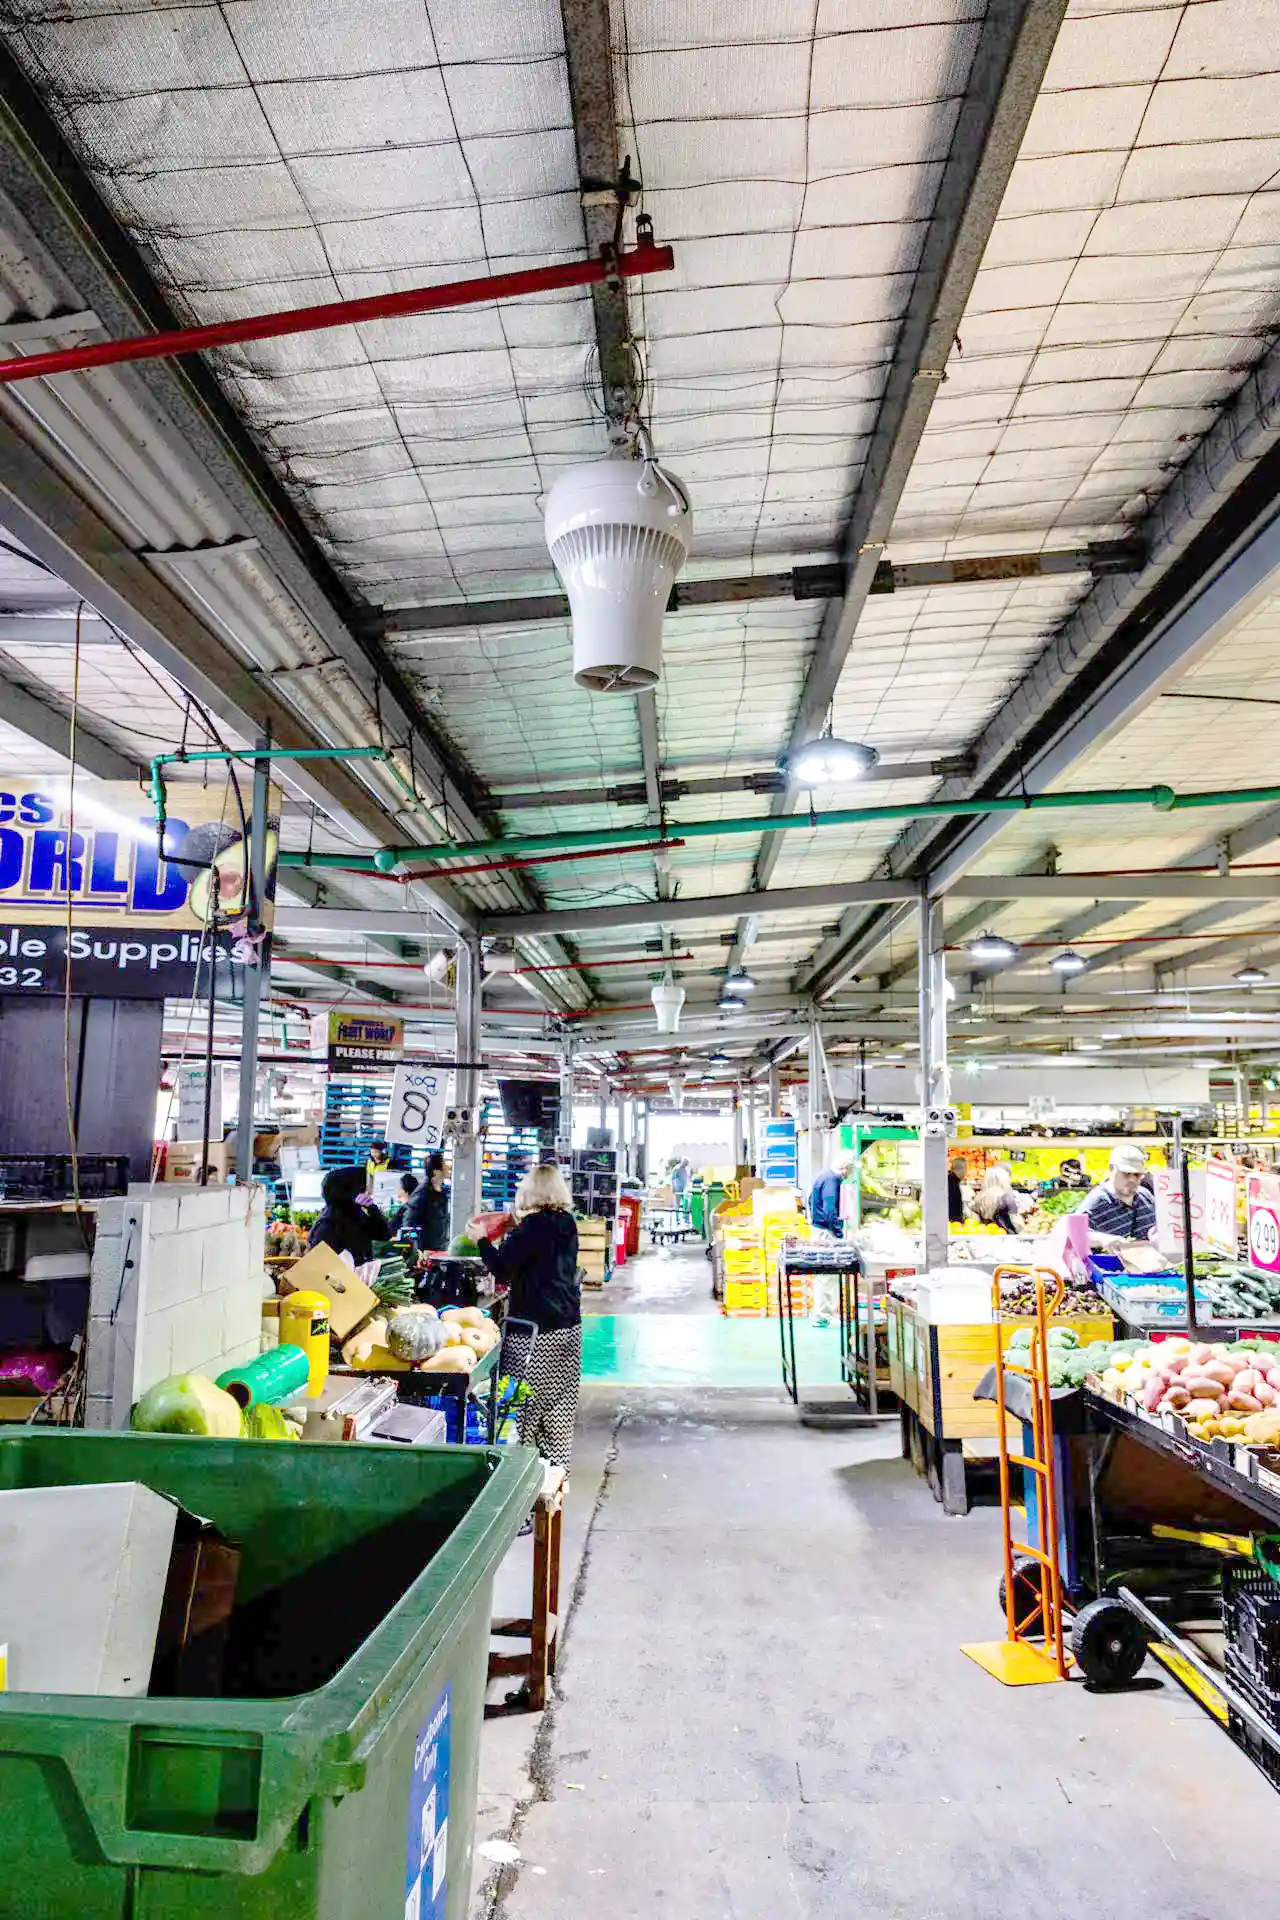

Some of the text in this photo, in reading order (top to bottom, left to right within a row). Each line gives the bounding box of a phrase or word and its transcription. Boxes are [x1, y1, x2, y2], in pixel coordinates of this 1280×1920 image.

[64, 931, 246, 969] Supplies
[336, 1046, 396, 1061] PLEASE PAY
[414, 1693, 448, 1770] Cardboard
